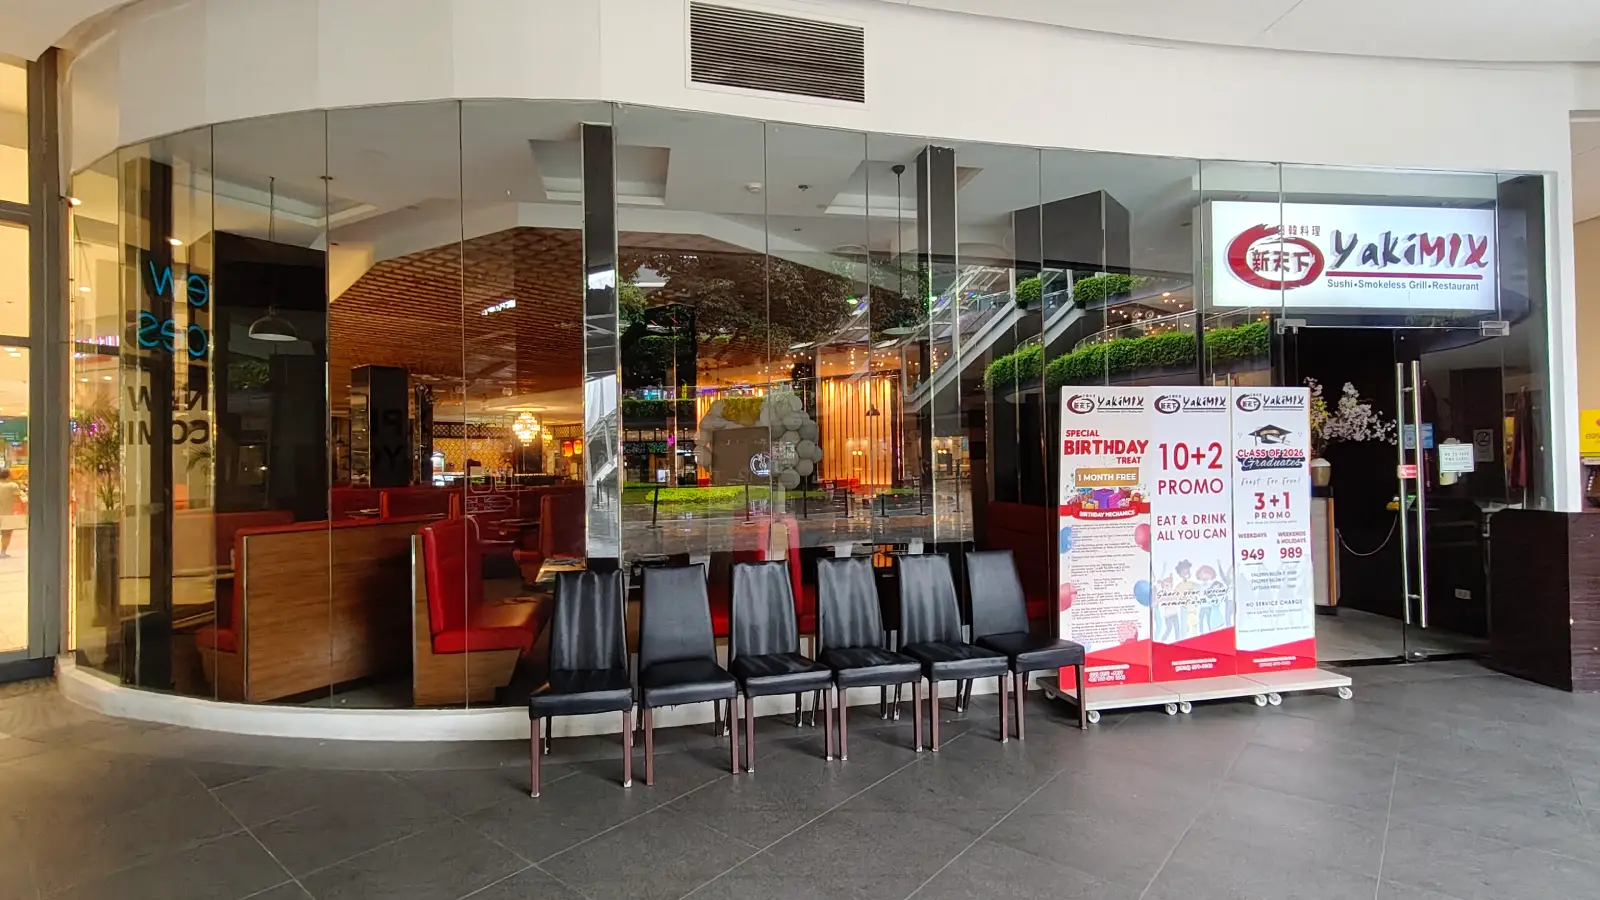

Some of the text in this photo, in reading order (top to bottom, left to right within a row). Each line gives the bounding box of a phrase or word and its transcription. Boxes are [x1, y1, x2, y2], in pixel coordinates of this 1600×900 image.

[1329, 229, 1489, 269] YakiMIX
[1064, 440, 1149, 455] BIRTHDAY
[1237, 448, 1304, 457] CLASS OF 2026
[1116, 456, 1141, 464] TREAT
[1158, 442, 1223, 470] 10+2
[1243, 457, 1301, 469] Graduates
[1158, 478, 1224, 495] PROMO
[1157, 513, 1227, 526] EAT & DRINK
[1254, 511, 1291, 519] PROMO
[1157, 528, 1227, 541] ALL YOU CAN
[1241, 548, 1265, 561] 949
[1280, 547, 1303, 559] 989
